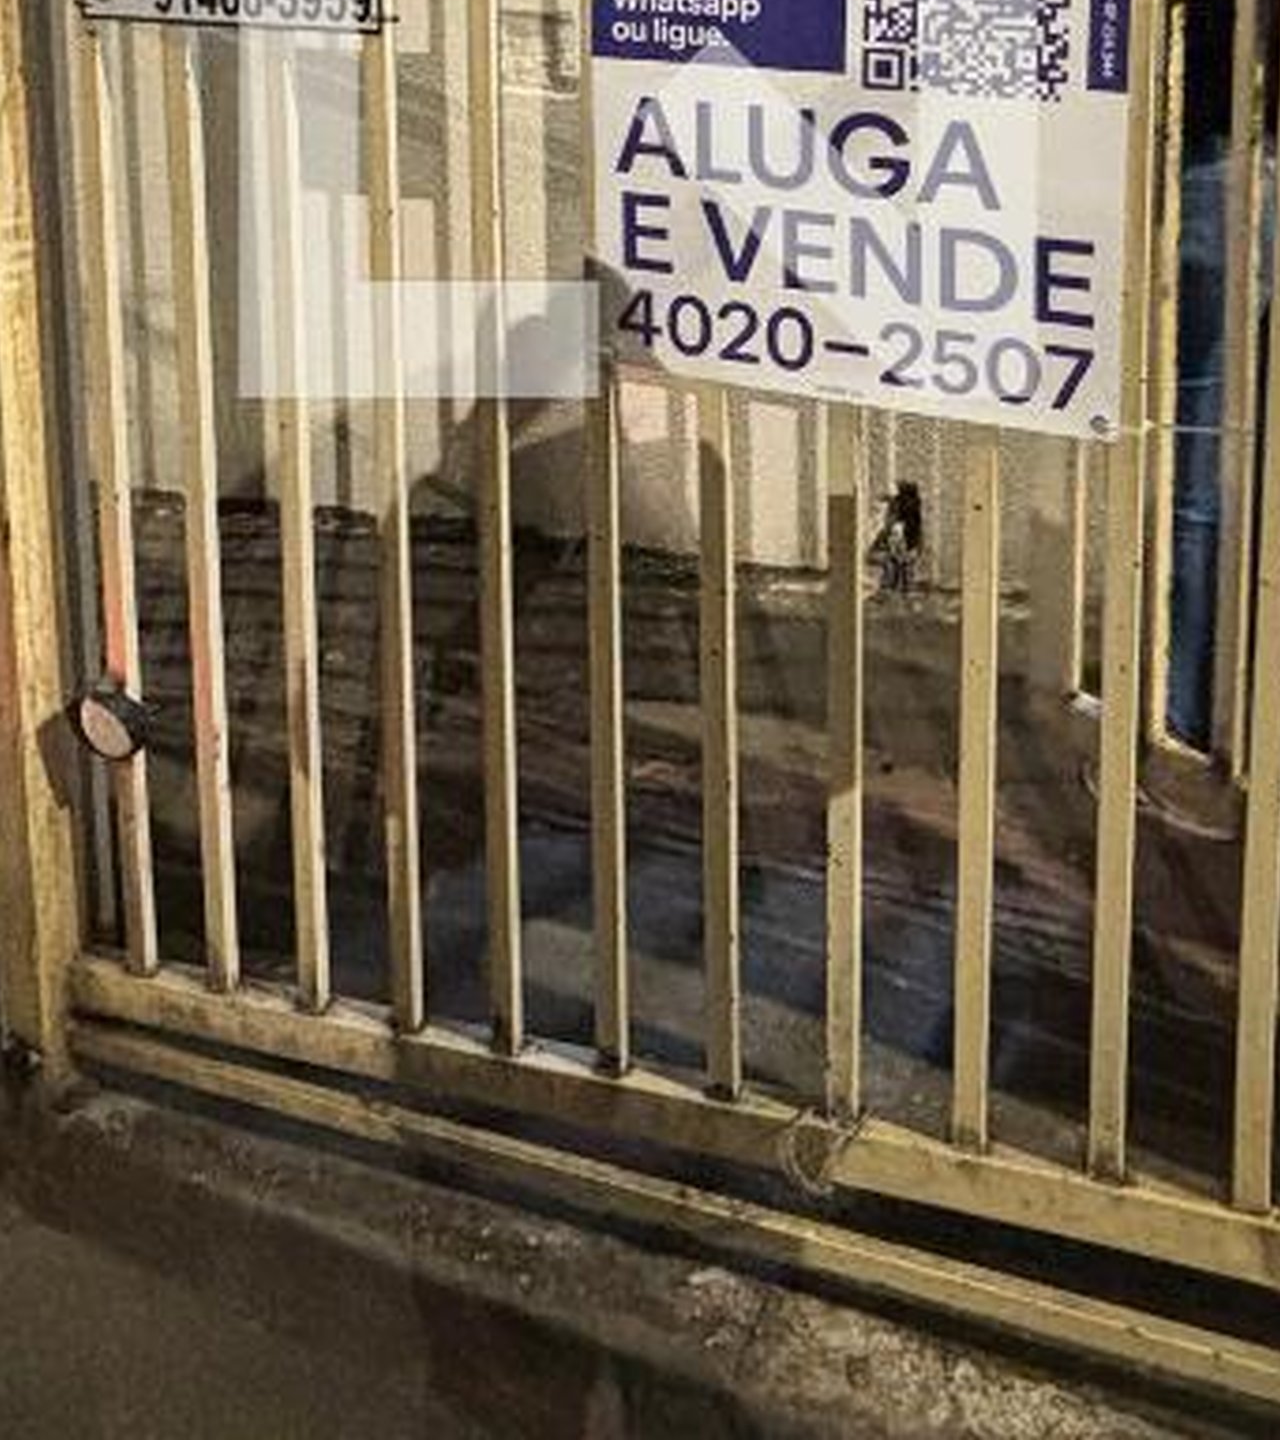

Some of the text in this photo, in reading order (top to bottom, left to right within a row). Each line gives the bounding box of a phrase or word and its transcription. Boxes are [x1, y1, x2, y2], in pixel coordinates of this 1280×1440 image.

[612, 21, 647, 42] ou
[615, 97, 1001, 210] ALUGA
[621, 191, 1094, 329] E VENDE
[619, 290, 1095, 411] 4020-2507
